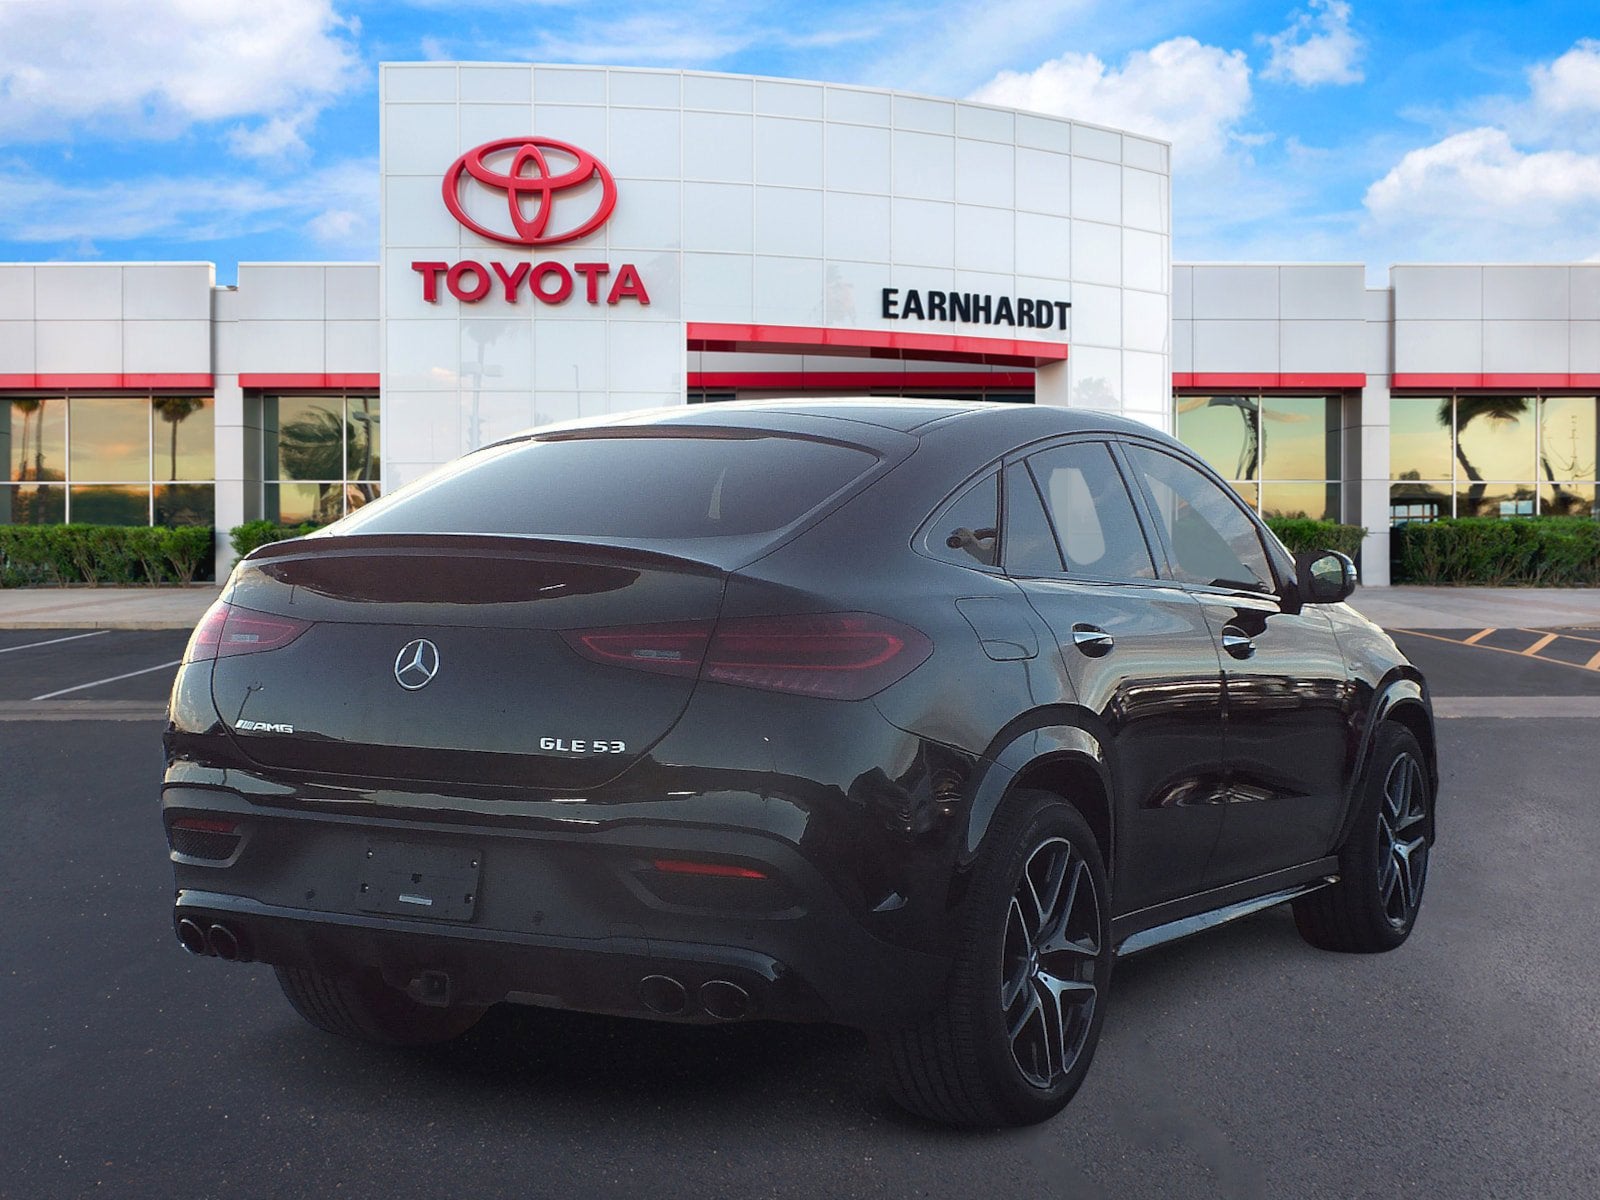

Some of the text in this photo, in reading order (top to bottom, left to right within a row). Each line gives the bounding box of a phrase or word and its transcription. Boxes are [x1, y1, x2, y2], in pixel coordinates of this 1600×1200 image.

[411, 260, 650, 304] TOYOTA
[882, 287, 1072, 330] EARNHARDT
[252, 722, 294, 734] AMG
[540, 737, 626, 754] GLE 53
